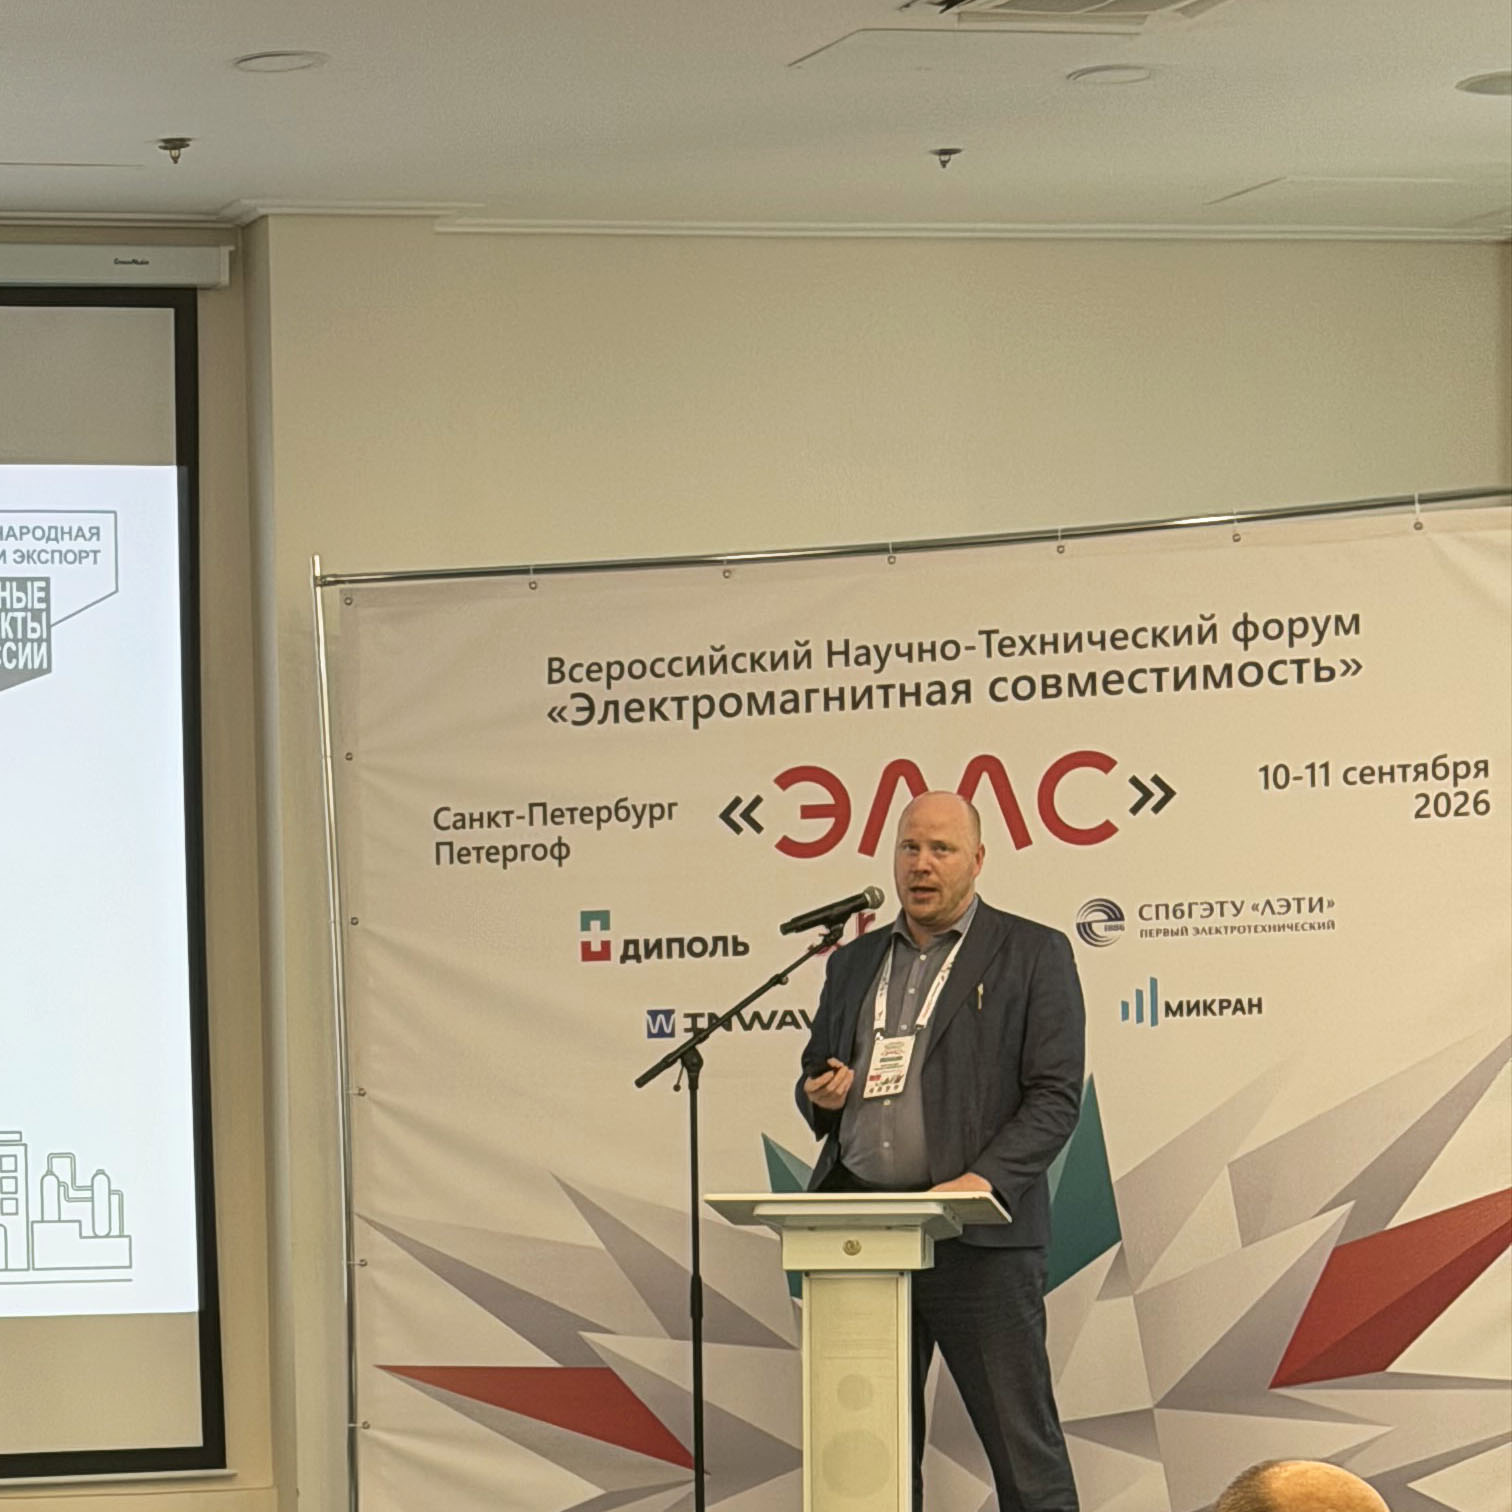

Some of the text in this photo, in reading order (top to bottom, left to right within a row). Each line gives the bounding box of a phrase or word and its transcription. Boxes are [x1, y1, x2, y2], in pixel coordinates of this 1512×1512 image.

[12, 548, 102, 565] ЭКСПОРТ
[546, 612, 1361, 690] Всероссийский Научно-Технический форум
[546, 656, 1364, 730] «Электромагнитная совместимость»
[1257, 753, 1489, 791] 10-11 сентября
[432, 796, 678, 831] Санкт-Петербург
[1413, 789, 1491, 820] 2026
[435, 836, 572, 870] Петергоф
[1137, 896, 1336, 921] СПбГЭТУ «ЛЭТИ»
[1139, 919, 1336, 939] ПЕРВЫЙ ЭЛЕКТРОТЕХНИЧЕСКИЙ
[619, 935, 750, 964] ДИПОЛЬ
[1164, 996, 1264, 1019] МИКРАН
